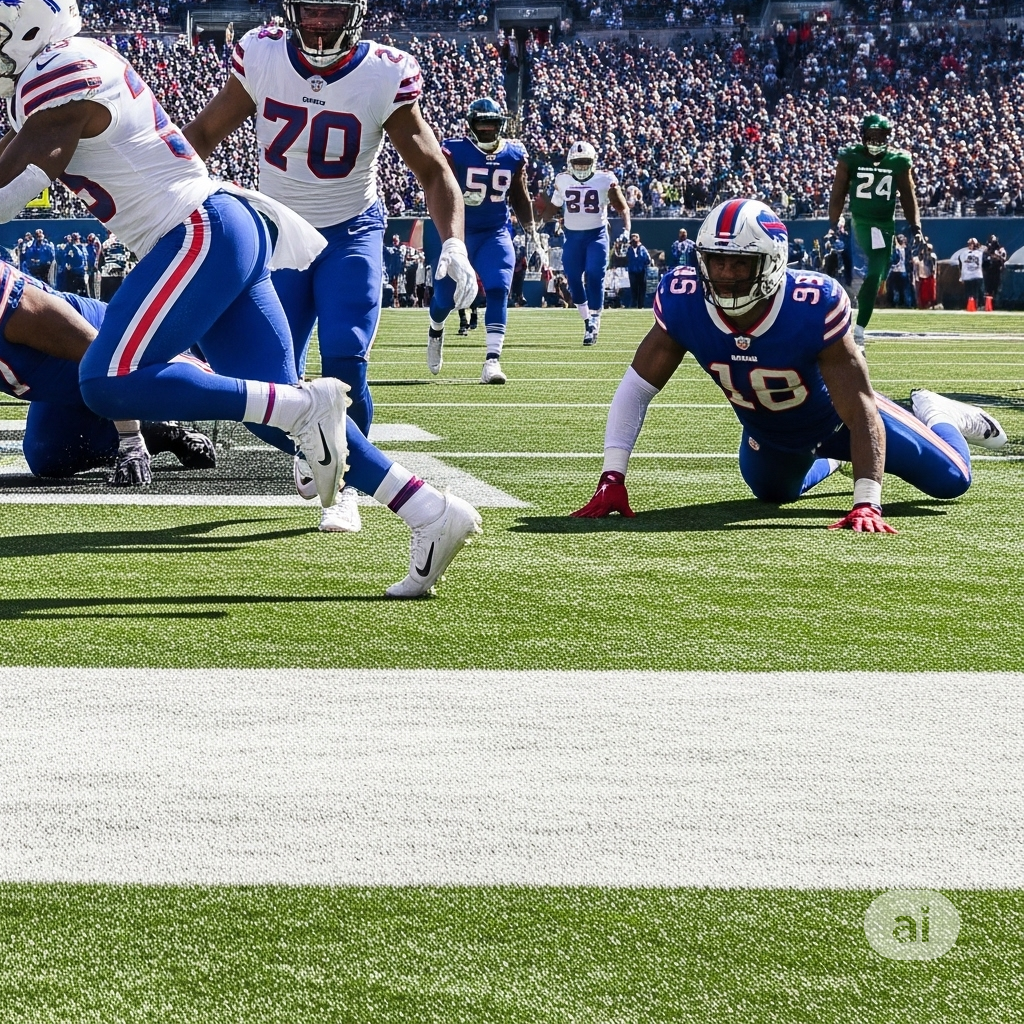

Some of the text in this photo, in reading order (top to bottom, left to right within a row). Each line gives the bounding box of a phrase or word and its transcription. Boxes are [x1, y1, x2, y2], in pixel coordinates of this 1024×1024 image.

[263, 97, 362, 179] 70
[463, 167, 512, 207] 59
[856, 172, 893, 201] 24
